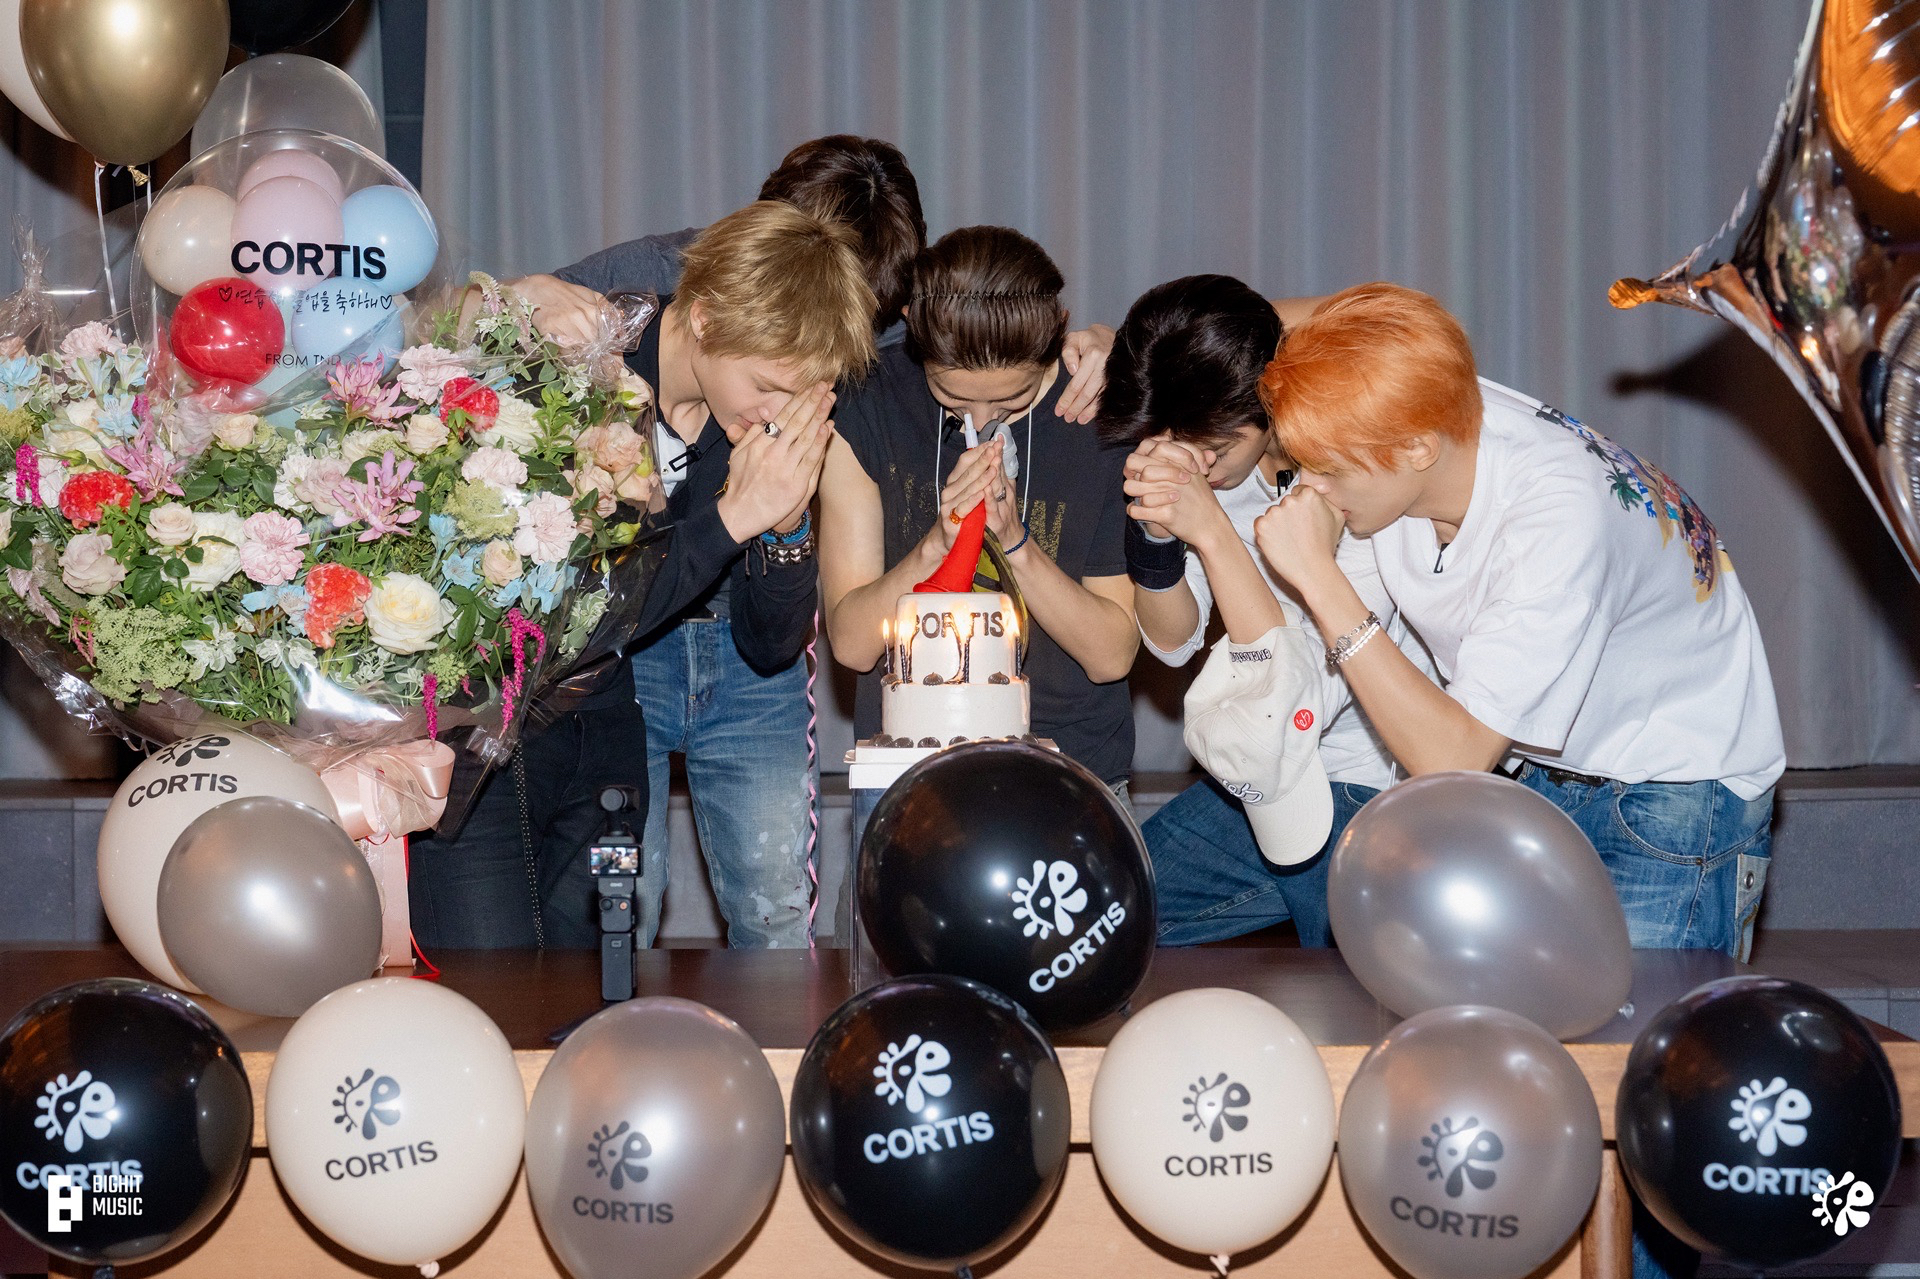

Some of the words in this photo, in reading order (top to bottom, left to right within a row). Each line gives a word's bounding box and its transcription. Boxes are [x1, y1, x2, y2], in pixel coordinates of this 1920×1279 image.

[231, 241, 387, 280] CORTIS
[236, 289, 282, 310] 연습
[336, 289, 378, 315] 축하해
[265, 354, 308, 366] FROM
[128, 773, 238, 808] CORTIS
[1028, 901, 1126, 993] CORTIS
[863, 1111, 995, 1164] CORTIS
[325, 1141, 438, 1180] CORTIS
[1164, 1152, 1273, 1177] CORTIS
[1702, 1162, 1832, 1196] CORTIS
[573, 1195, 674, 1224] CORTIS
[1390, 1196, 1519, 1238] CORTIS
